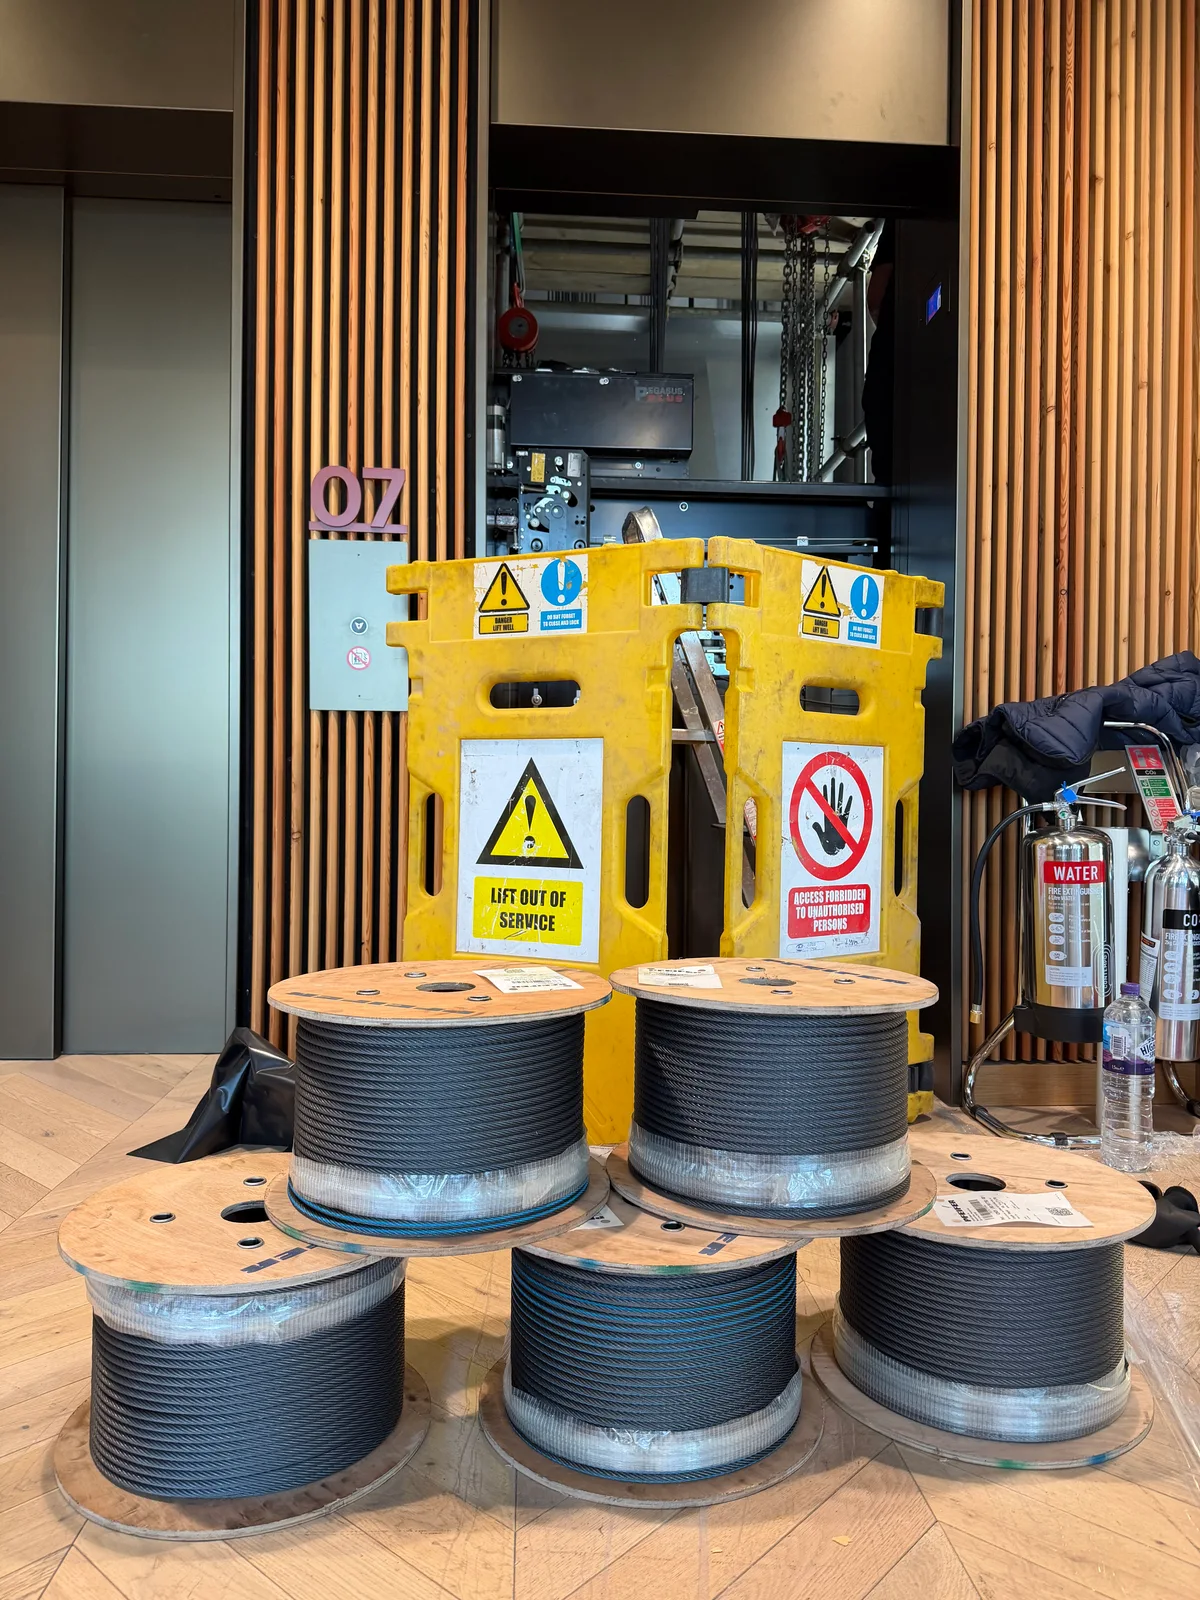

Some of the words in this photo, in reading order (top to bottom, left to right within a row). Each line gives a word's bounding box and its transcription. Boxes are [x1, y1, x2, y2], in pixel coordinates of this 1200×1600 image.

[635, 386, 683, 401] PEGASUS
[310, 465, 406, 528] 07
[1054, 866, 1098, 881] WATER
[491, 887, 516, 904] LIFT
[520, 889, 547, 906] OUT
[550, 891, 566, 907] OF
[794, 891, 824, 905] ACCESS
[825, 889, 866, 902] FORBIDDEN
[1048, 887, 1061, 895] FIRE
[796, 906, 806, 919] TO
[808, 903, 864, 918] UNAUTHORISED
[500, 912, 555, 931] SERVICE
[814, 918, 847, 932] PERSONS
[1183, 914, 1200, 926] CO
[948, 1200, 971, 1223] PFEIFER
